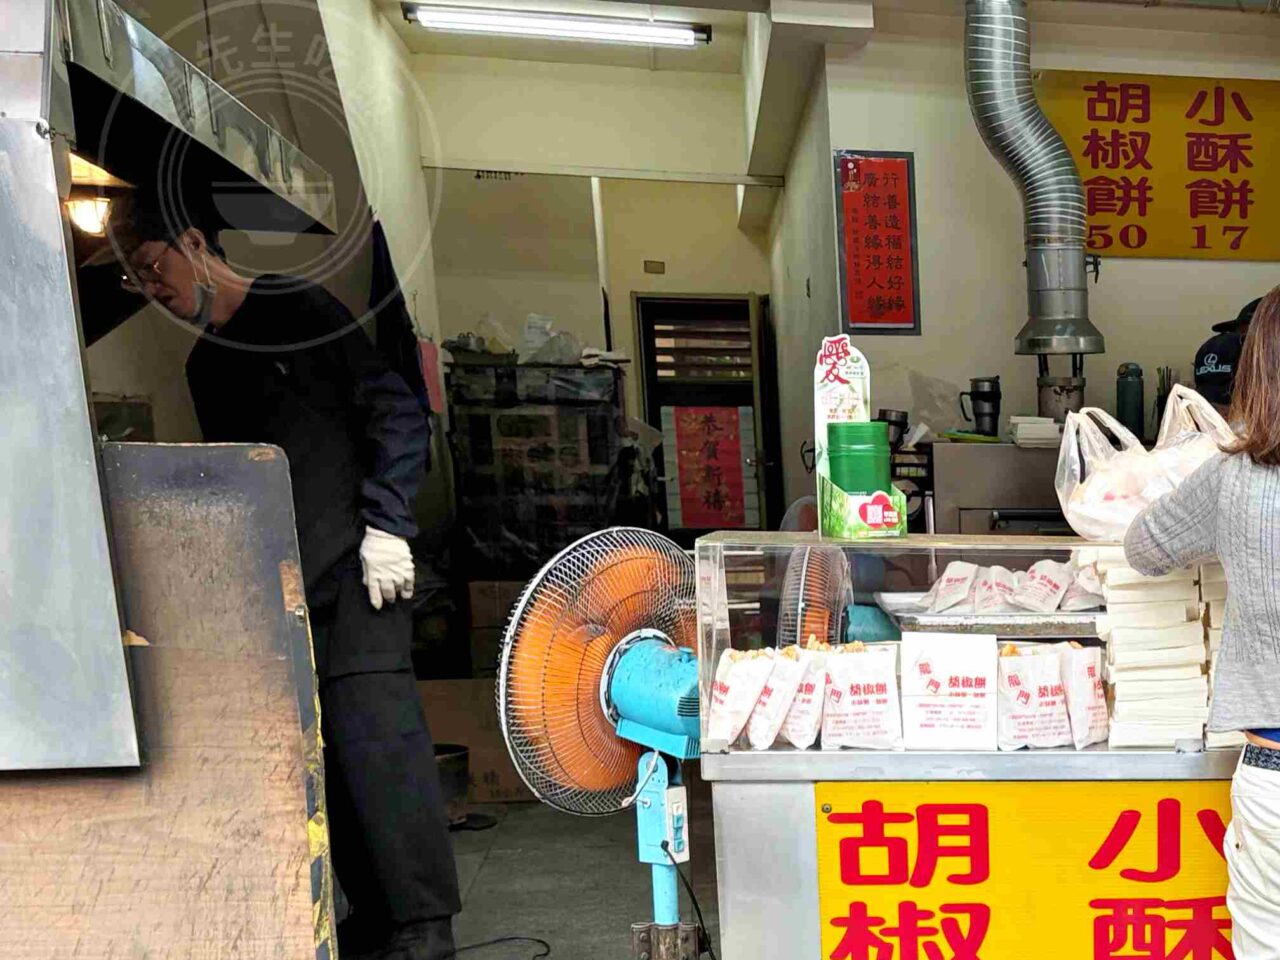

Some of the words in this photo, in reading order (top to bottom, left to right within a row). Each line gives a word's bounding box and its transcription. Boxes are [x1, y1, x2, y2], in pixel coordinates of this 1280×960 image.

[1082, 80, 1153, 217] 胡椒餅
[1185, 86, 1254, 219] 小酥餅
[1086, 224, 1147, 249] 50
[1191, 225, 1249, 250] 17
[1196, 364, 1232, 376] LEXUS
